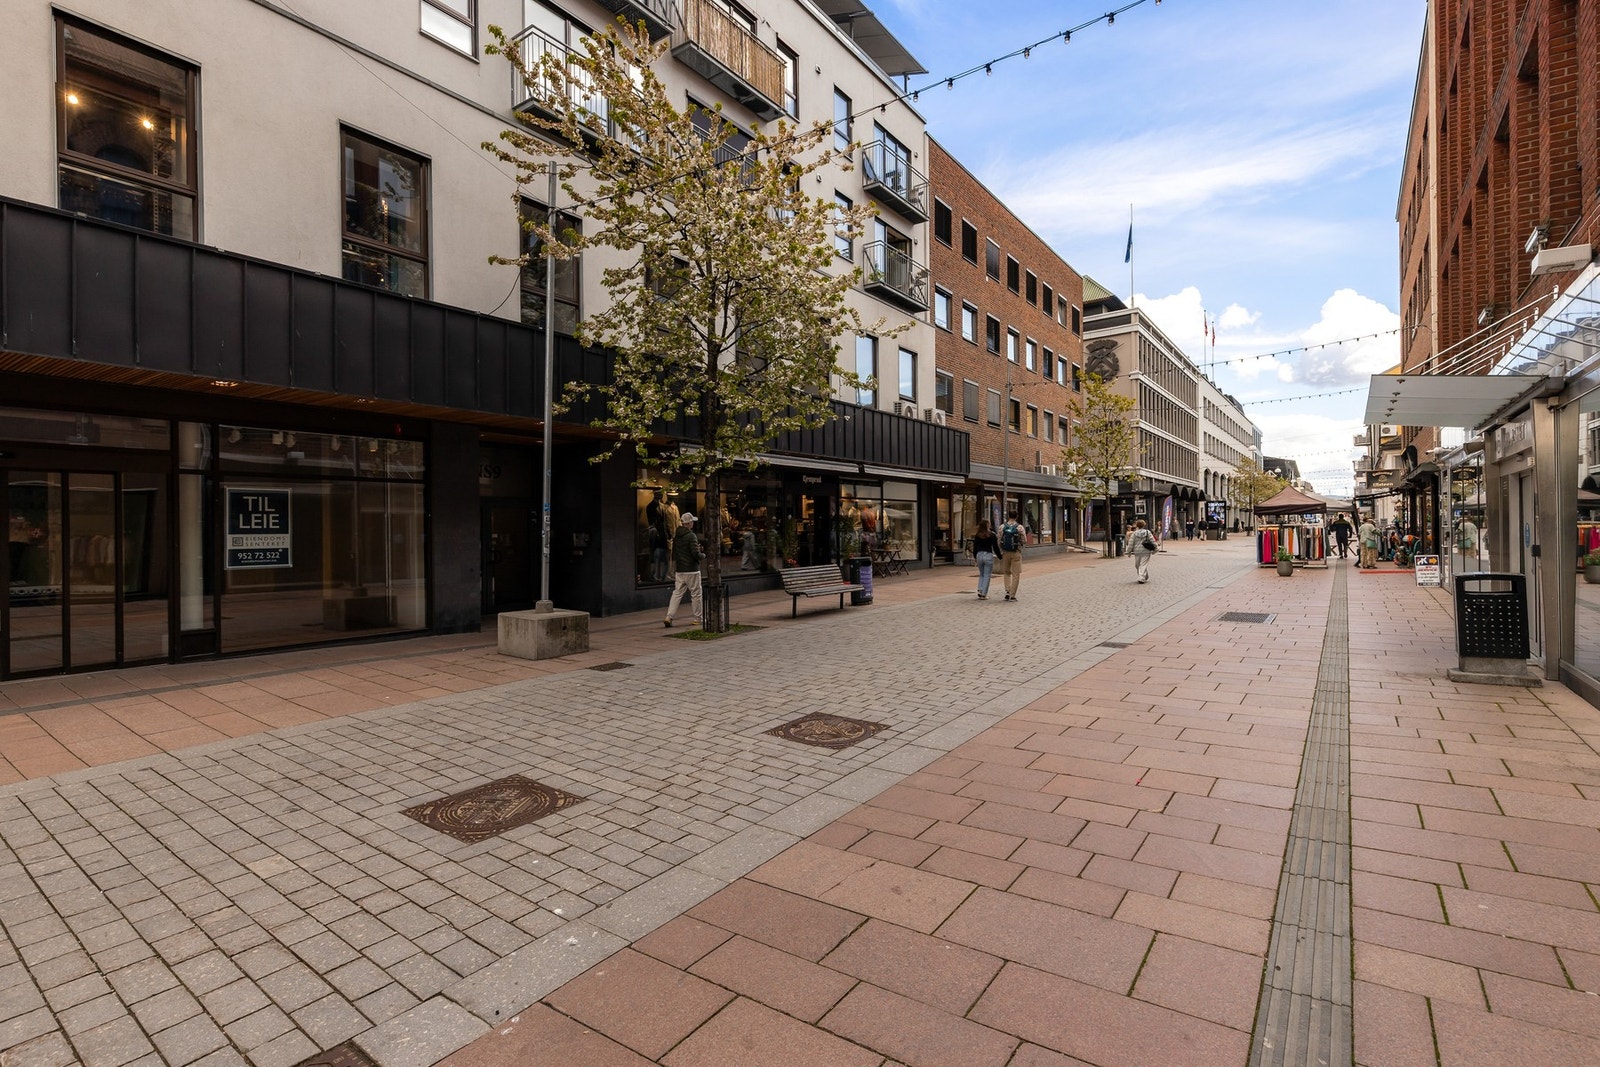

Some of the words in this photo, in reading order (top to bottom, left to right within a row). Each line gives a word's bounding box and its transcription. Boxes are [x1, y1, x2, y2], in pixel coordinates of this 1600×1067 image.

[243, 496, 275, 511] TIL
[239, 514, 279, 528] LEIE
[238, 552, 252, 560] 952
[266, 551, 280, 559] 522
